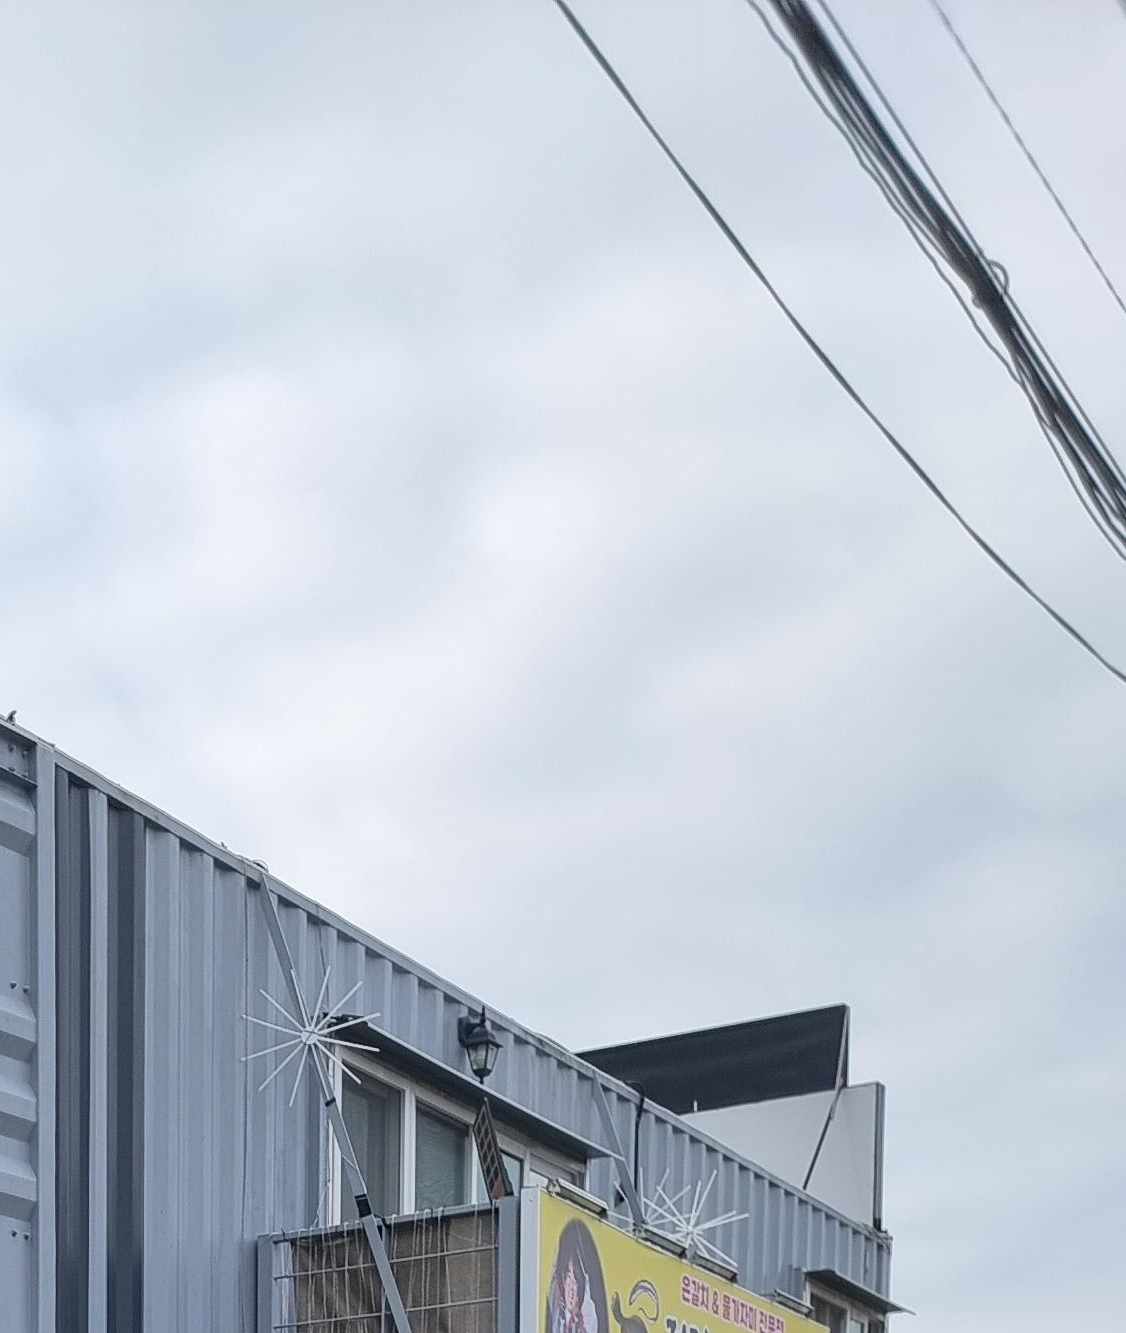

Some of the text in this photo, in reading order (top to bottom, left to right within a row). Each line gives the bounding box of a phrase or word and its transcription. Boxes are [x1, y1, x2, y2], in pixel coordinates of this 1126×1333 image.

[682, 1276, 709, 1311] 은갈치
[712, 1289, 720, 1315] &
[723, 1294, 757, 1331] 물가자미
